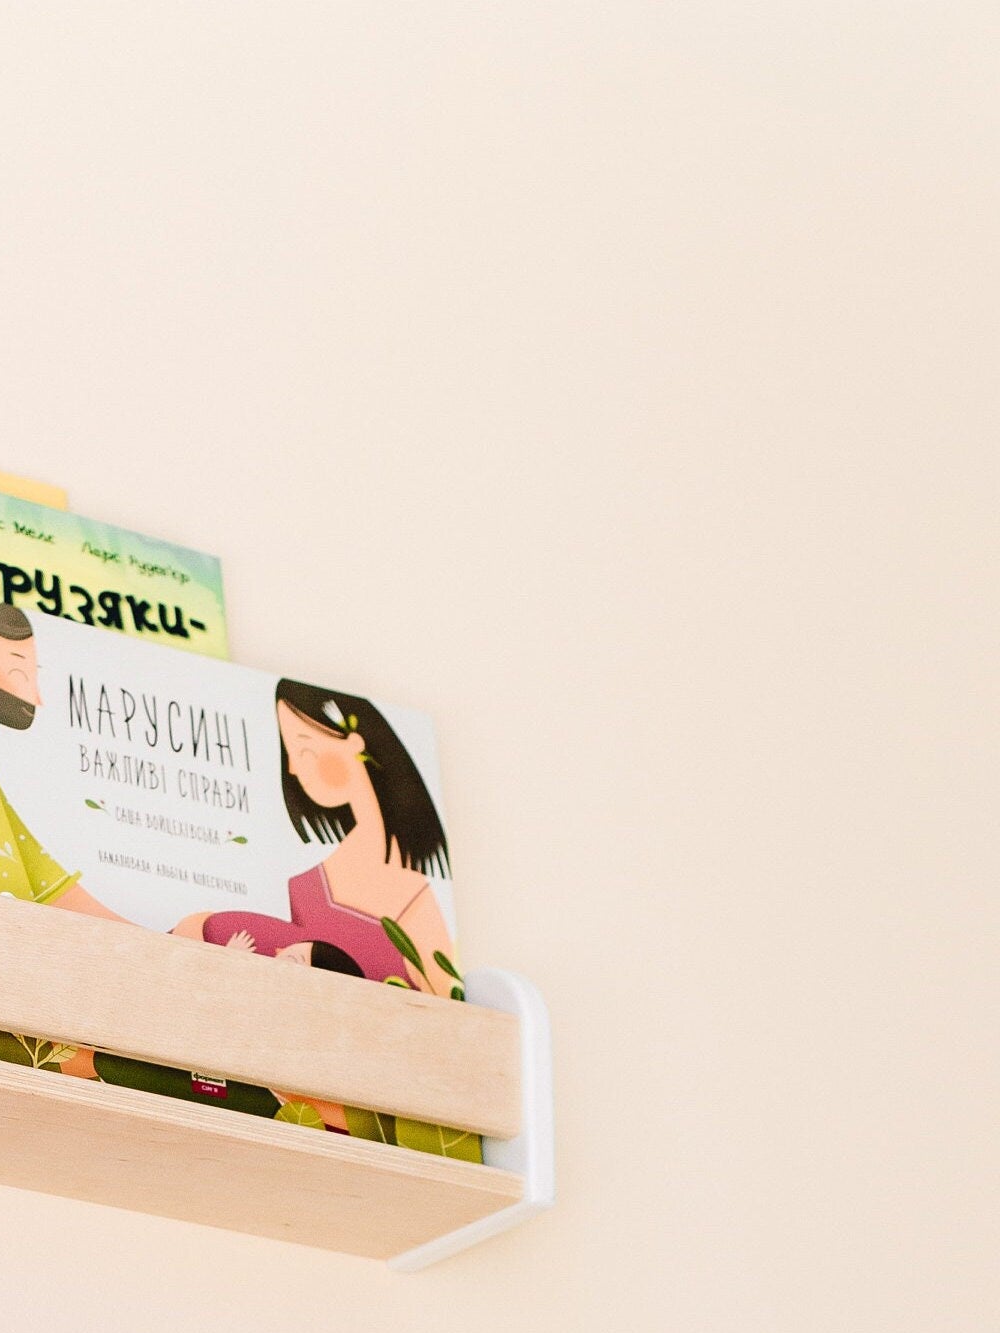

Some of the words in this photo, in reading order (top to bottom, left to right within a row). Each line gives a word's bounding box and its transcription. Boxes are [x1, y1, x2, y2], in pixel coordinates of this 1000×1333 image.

[69, 673, 251, 772] МАРУСИНІ
[79, 744, 168, 794] ВАЖЛИВІ
[178, 768, 250, 814] СПРАВИ
